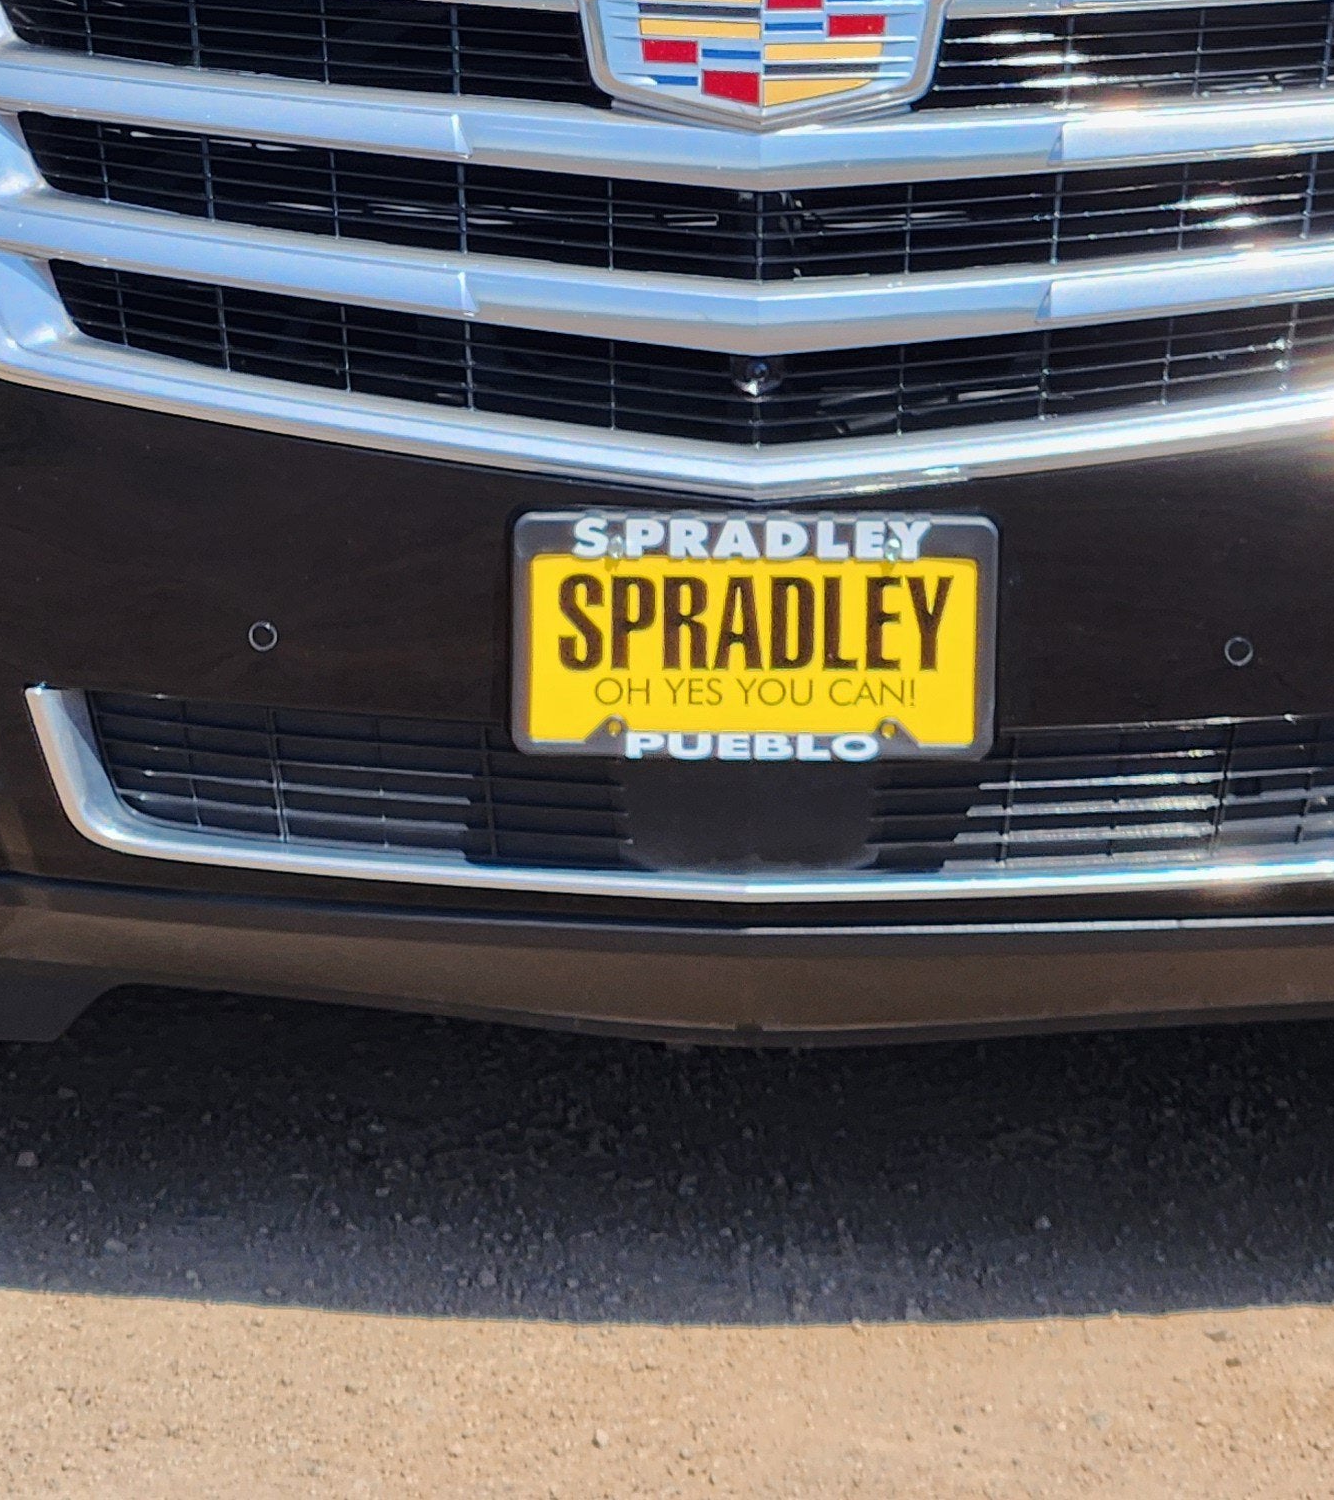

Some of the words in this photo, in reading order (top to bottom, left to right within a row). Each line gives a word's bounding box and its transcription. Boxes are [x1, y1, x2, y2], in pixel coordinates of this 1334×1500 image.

[571, 516, 932, 561] SPRADLEY
[557, 573, 955, 671] SPRADLEY
[594, 677, 651, 706] OH
[665, 677, 723, 706] YES
[736, 677, 814, 706] YOU
[829, 677, 916, 707] CAN!
[624, 732, 880, 763] PUEBLO
